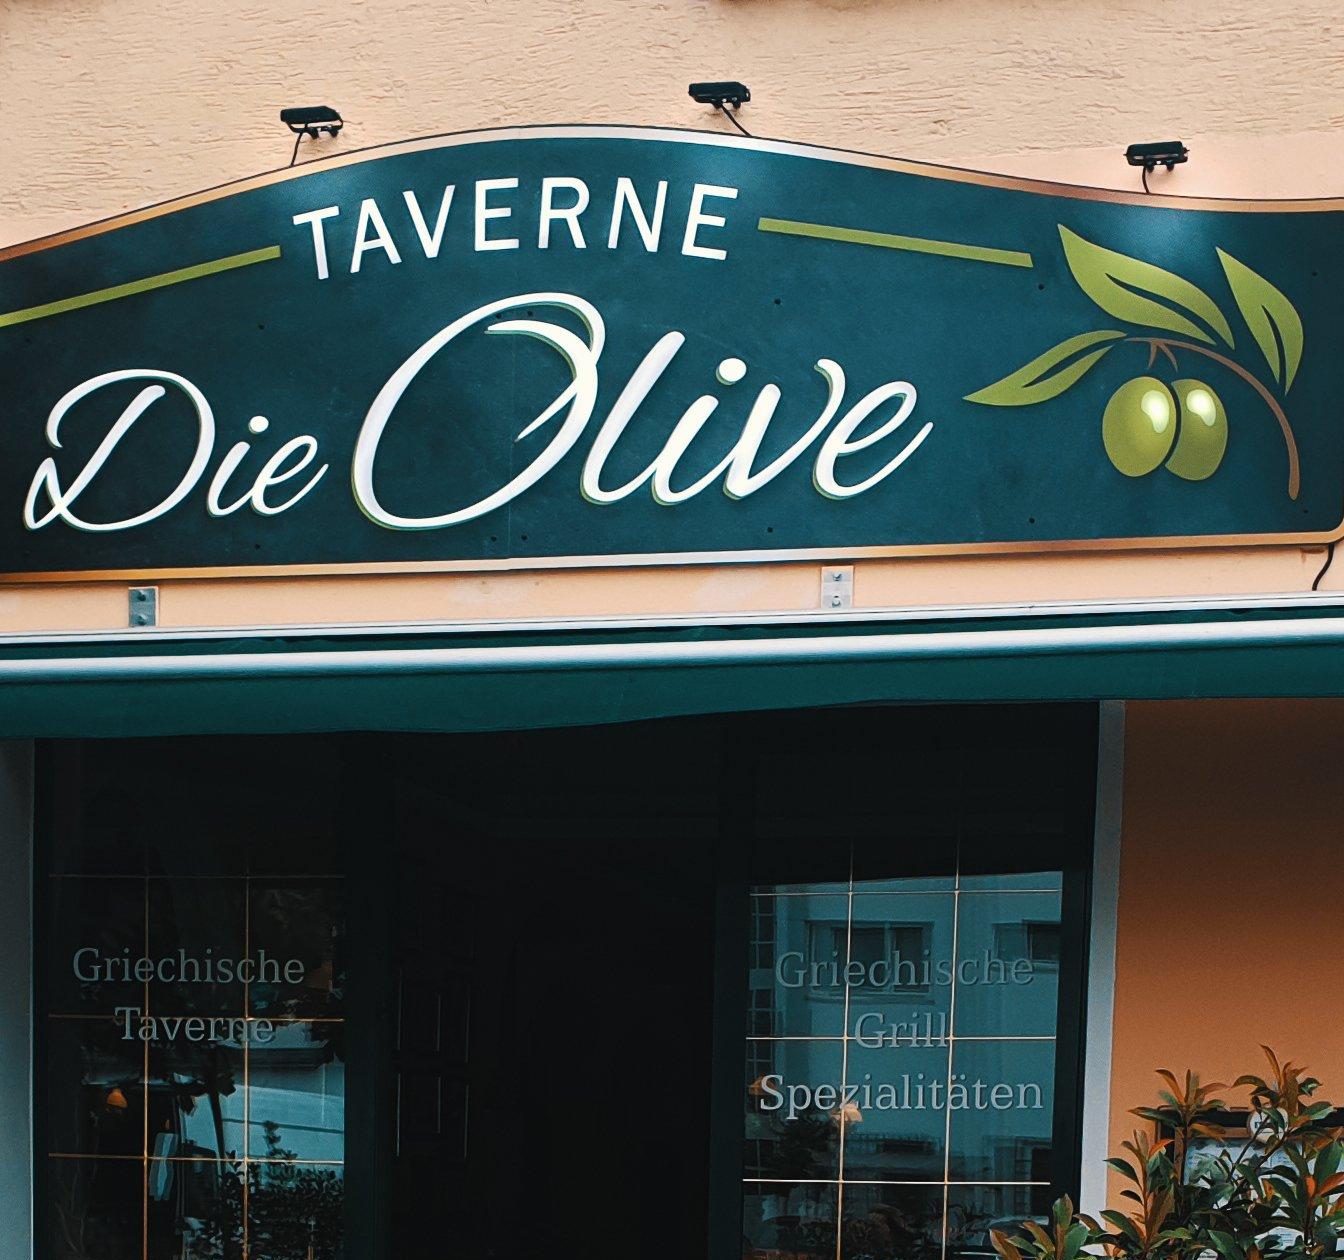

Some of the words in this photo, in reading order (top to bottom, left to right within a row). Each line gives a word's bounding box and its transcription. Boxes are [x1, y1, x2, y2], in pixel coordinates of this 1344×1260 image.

[293, 176, 739, 280] TAVERNE
[23, 368, 328, 533] Die
[351, 291, 934, 531] Olive
[73, 947, 305, 984] Griechische
[775, 949, 1036, 988] Griechische
[114, 1006, 274, 1043] Taverne
[855, 1012, 949, 1048] Grill
[759, 1074, 1044, 1120] Spezialitäten
